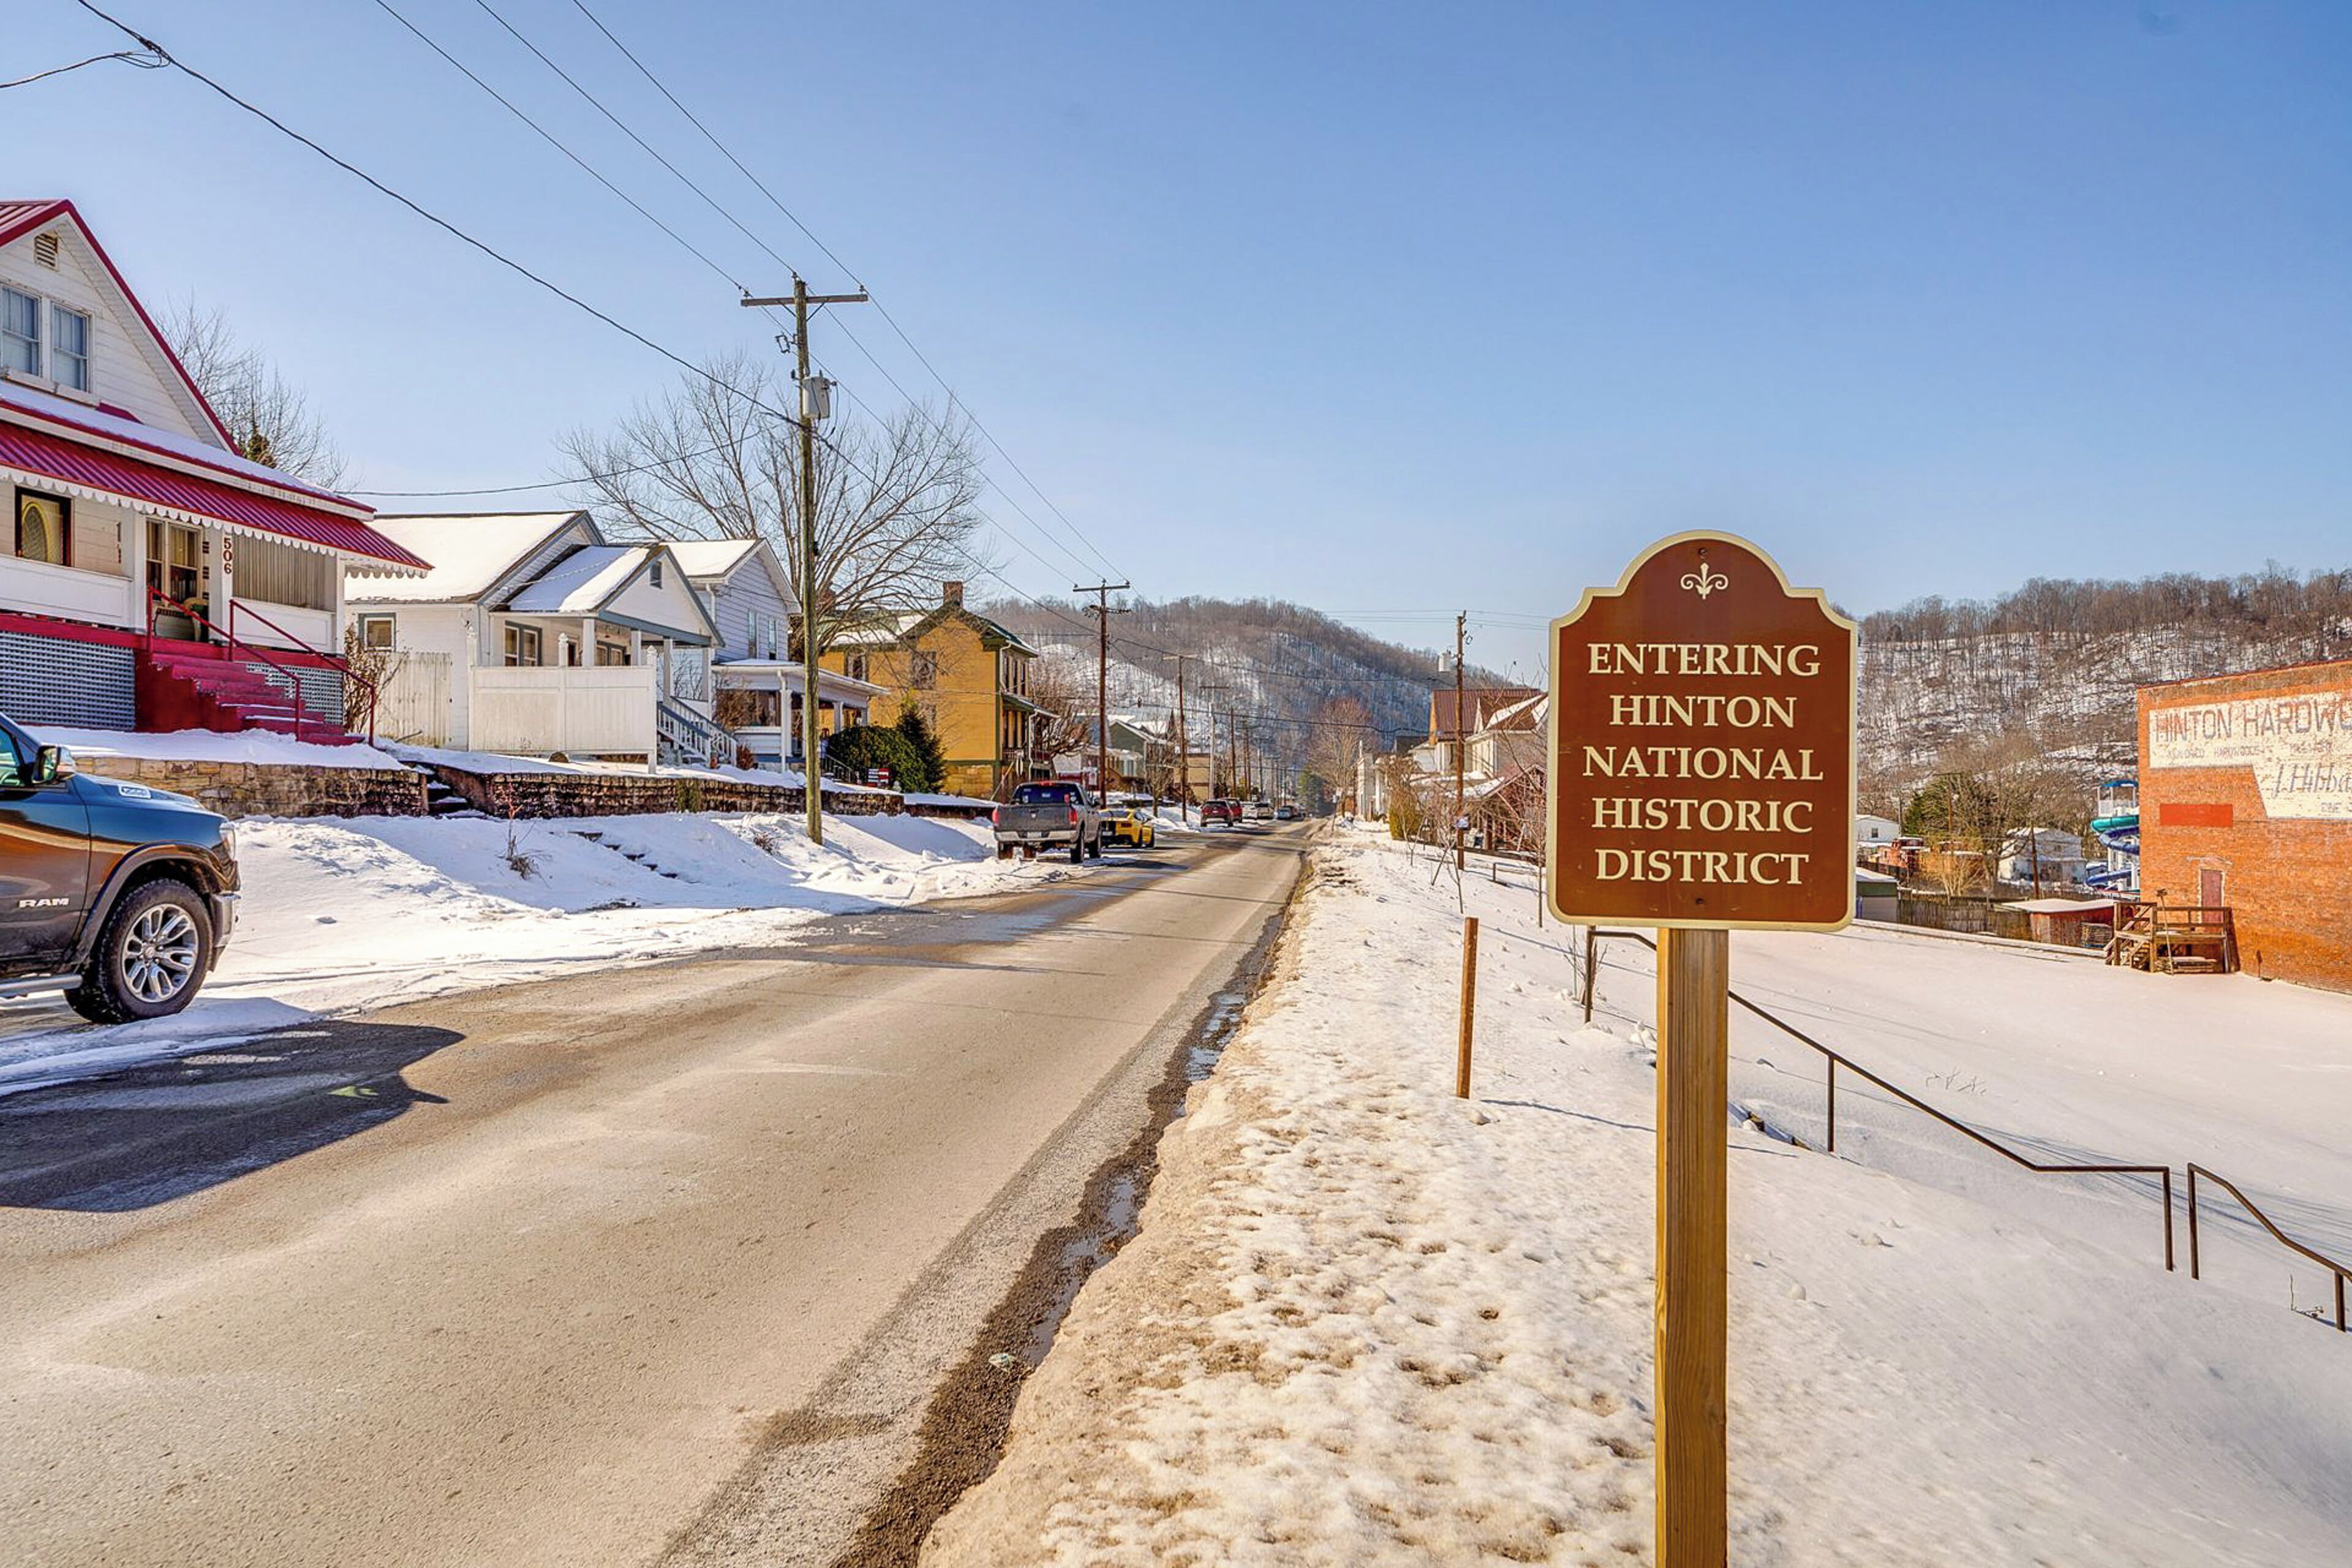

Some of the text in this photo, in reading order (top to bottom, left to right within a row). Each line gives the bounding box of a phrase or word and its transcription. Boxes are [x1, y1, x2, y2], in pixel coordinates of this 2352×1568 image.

[223, 537, 232, 575] 506
[1587, 643, 1820, 676] ENTERING
[1609, 695, 1797, 728] HINTON
[2156, 708, 2231, 742] HINTON
[1582, 745, 1824, 780] NATIONAL
[1591, 797, 1813, 833] HISTORIC
[1595, 849, 1809, 884] DISTRICT
[19, 897, 69, 908] RAM
